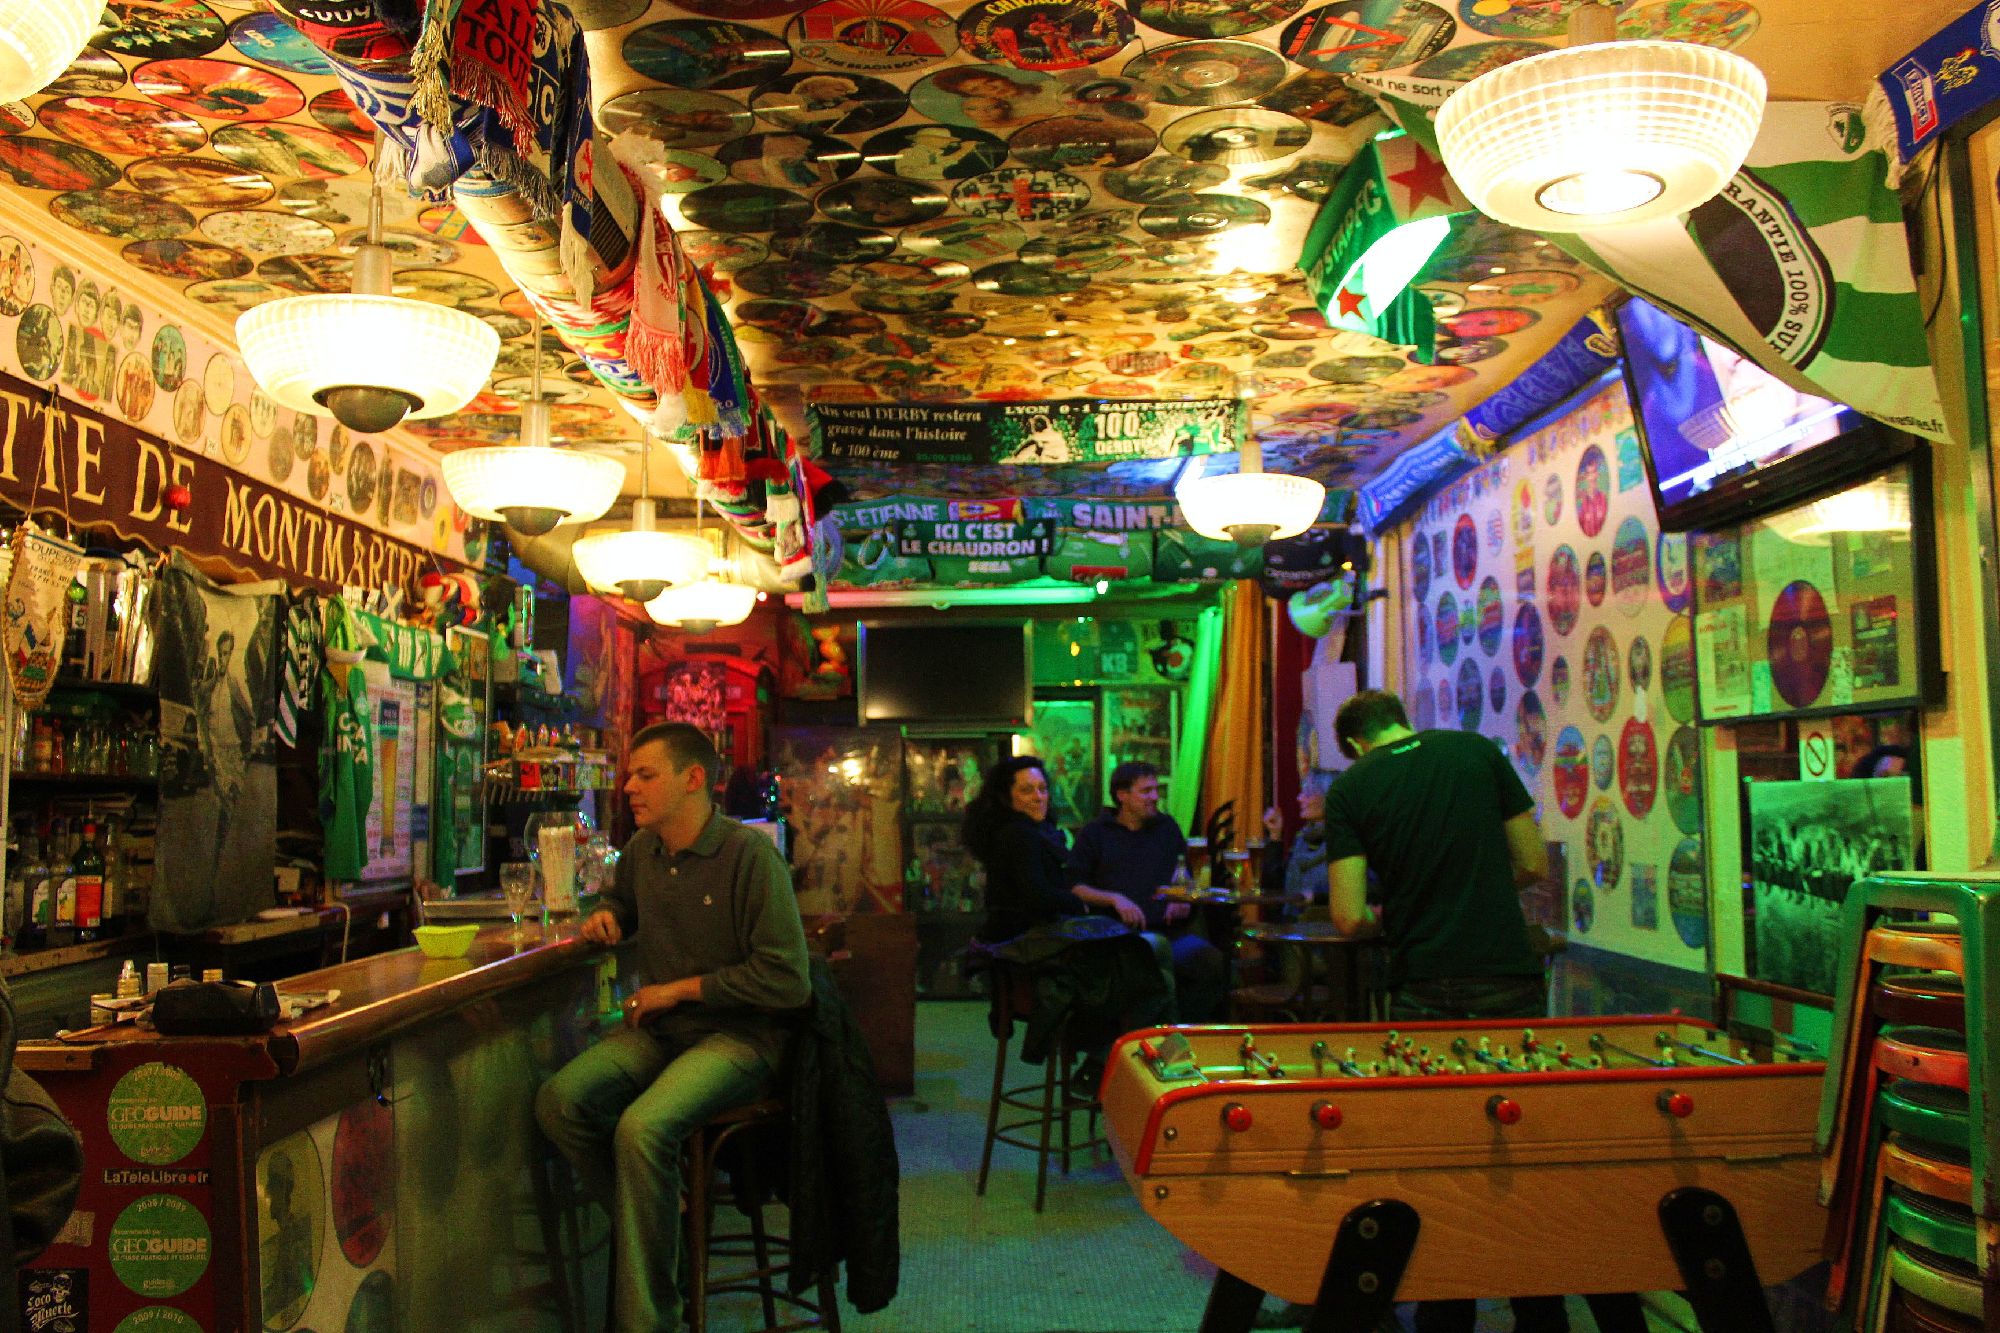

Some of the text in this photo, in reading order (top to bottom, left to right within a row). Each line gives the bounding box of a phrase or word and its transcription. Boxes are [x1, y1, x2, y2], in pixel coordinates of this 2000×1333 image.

[1389, 81, 1407, 92] ne
[1412, 83, 1441, 97] sort
[1786, 270, 1810, 315] 100%
[843, 408, 871, 419] seul
[875, 407, 929, 421] DERBY
[933, 409, 982, 422] restera
[1005, 405, 1050, 415] LYON
[868, 425, 900, 438] dans
[905, 426, 967, 441] l'histoire
[1095, 411, 1140, 439] 100
[848, 444, 870, 458] 100
[128, 437, 196, 534] DE
[934, 523, 1016, 540] ICI C'EST
[901, 539, 1049, 556] LE CHAUDRON !
[112, 1238, 208, 1254] GEOGUIDE
